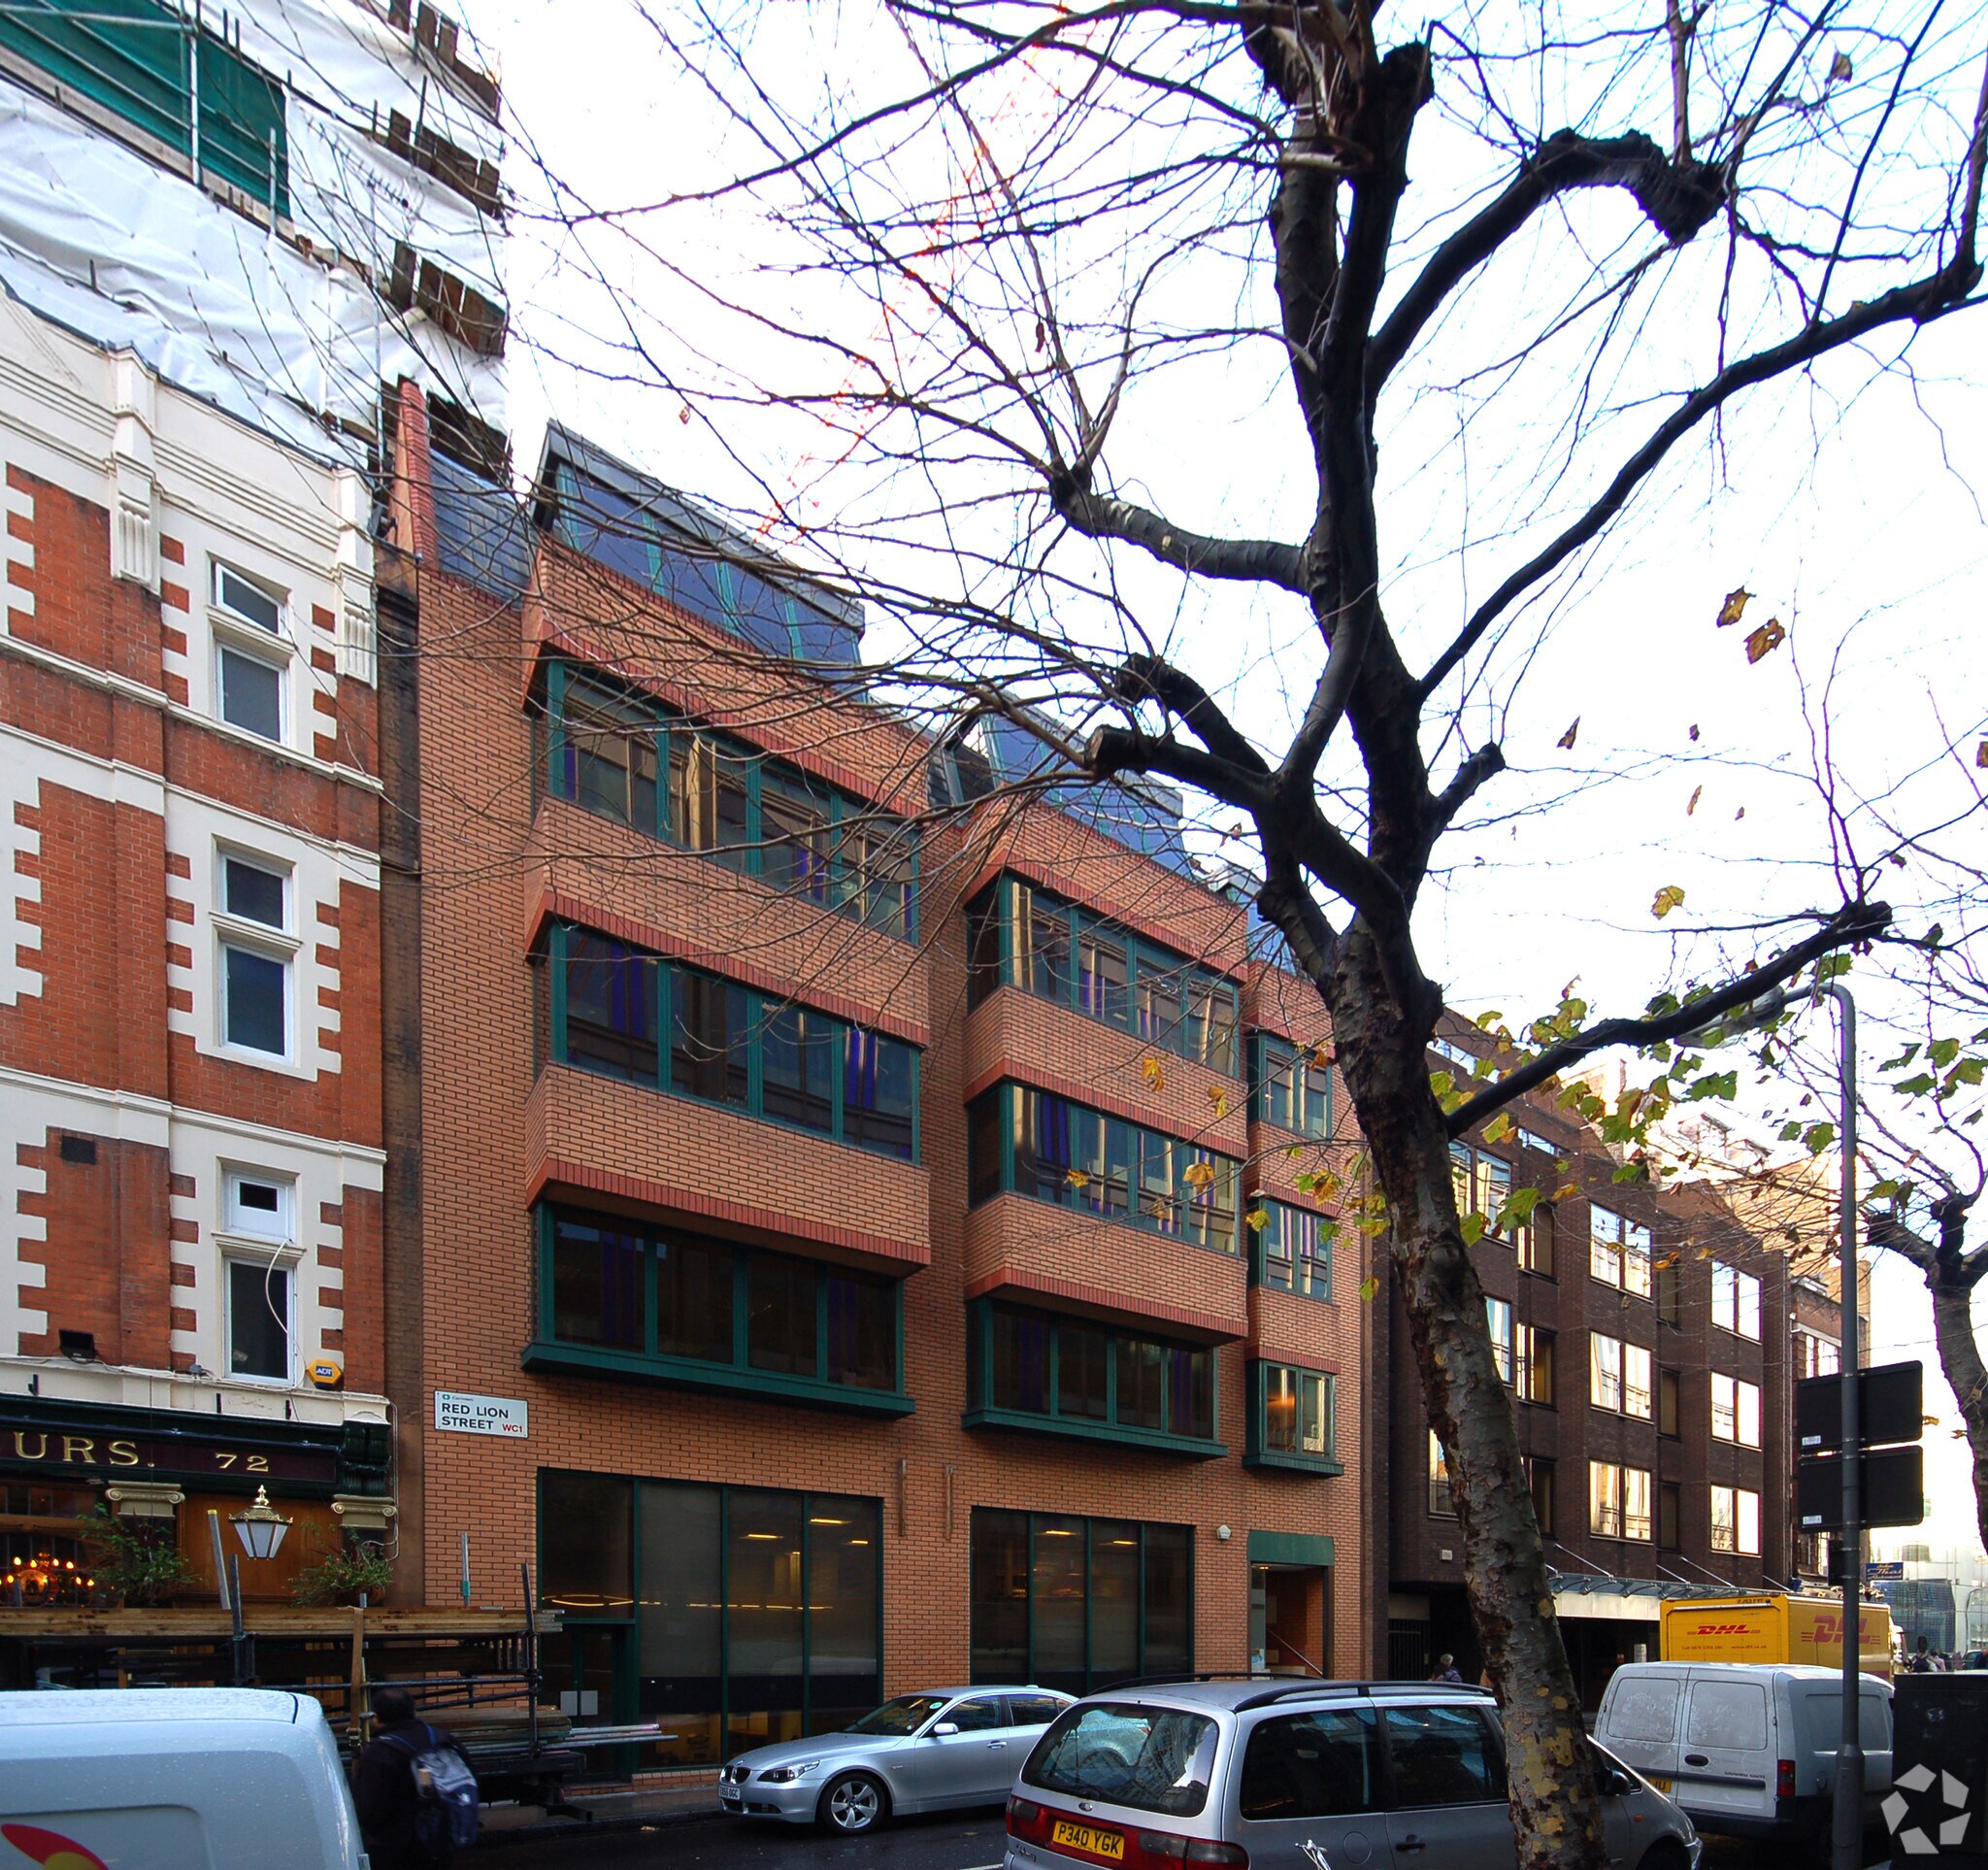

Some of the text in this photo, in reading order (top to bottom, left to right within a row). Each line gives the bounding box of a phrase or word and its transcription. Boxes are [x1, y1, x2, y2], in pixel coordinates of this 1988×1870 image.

[442, 1403, 509, 1419] RED LION
[442, 1416, 523, 1432] STREET WC1
[14, 1431, 269, 1473] URS. 72
[1697, 1624, 1750, 1635] DHL
[1058, 1823, 1090, 1847] P340
[1094, 1831, 1121, 1854] YGK
